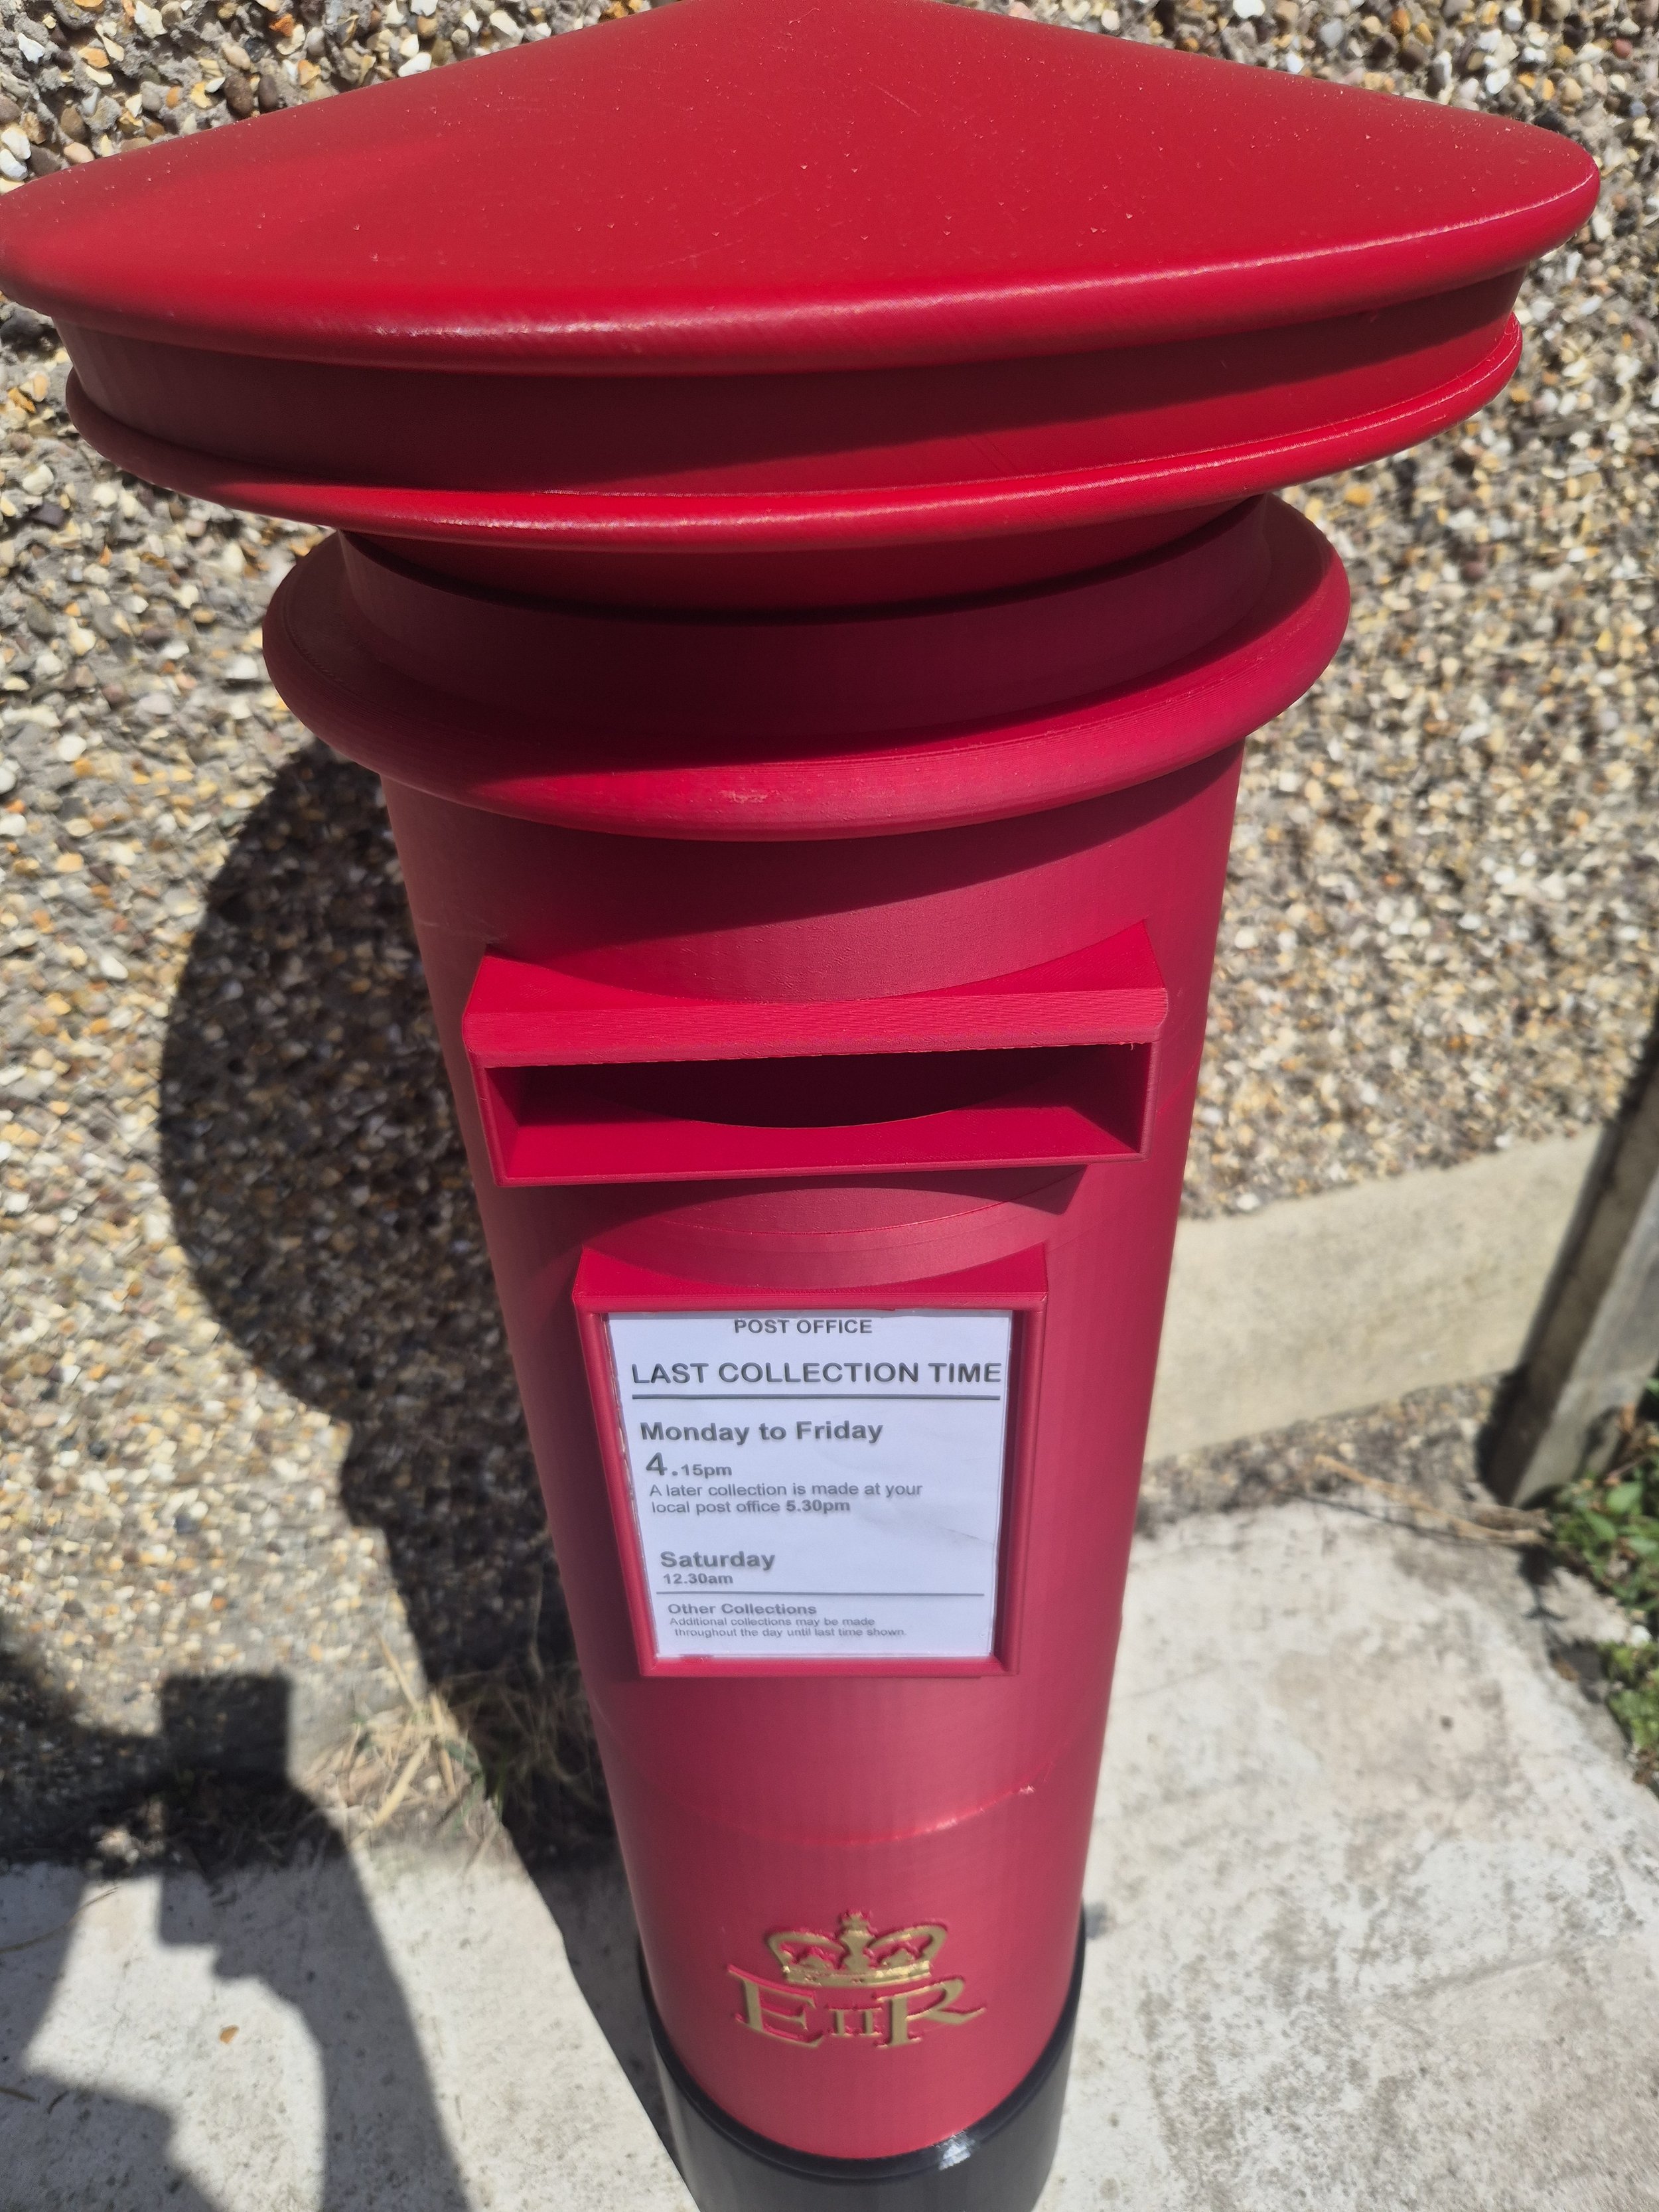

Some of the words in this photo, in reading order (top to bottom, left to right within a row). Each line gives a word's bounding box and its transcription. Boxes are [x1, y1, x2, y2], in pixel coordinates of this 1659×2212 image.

[733, 1318, 789, 1334] POST
[796, 1318, 873, 1334] OFFICE
[631, 1363, 709, 1384] LAST
[718, 1362, 919, 1383] COLLECTION
[927, 1363, 1002, 1383] TIME
[640, 1422, 750, 1446] Monday
[758, 1422, 787, 1441] to
[796, 1420, 884, 1445] Friday
[649, 1484, 663, 1497] A
[666, 1484, 703, 1497] later
[707, 1483, 787, 1497] collection
[792, 1482, 806, 1497] is
[812, 1481, 859, 1498] made
[863, 1482, 881, 1497] at
[885, 1485, 923, 1499] your
[652, 1501, 690, 1514] local
[695, 1501, 731, 1516] post
[735, 1500, 781, 1514] office
[786, 1499, 851, 1515] 5.30pm
[660, 1550, 776, 1572] Saturday
[663, 1572, 734, 1585] 12.30am
[668, 1603, 717, 1615] Other
[721, 1603, 818, 1615] Collections
[670, 1617, 727, 1627] Additional
[730, 1617, 792, 1627] collections
[795, 1617, 820, 1629] may
[824, 1617, 839, 1627] be
[841, 1617, 875, 1627] made
[674, 1628, 737, 1639] throughout
[740, 1627, 758, 1637] the
[762, 1627, 783, 1639] day
[786, 1627, 812, 1637] until
[814, 1627, 835, 1637] last
[837, 1628, 863, 1637] time
